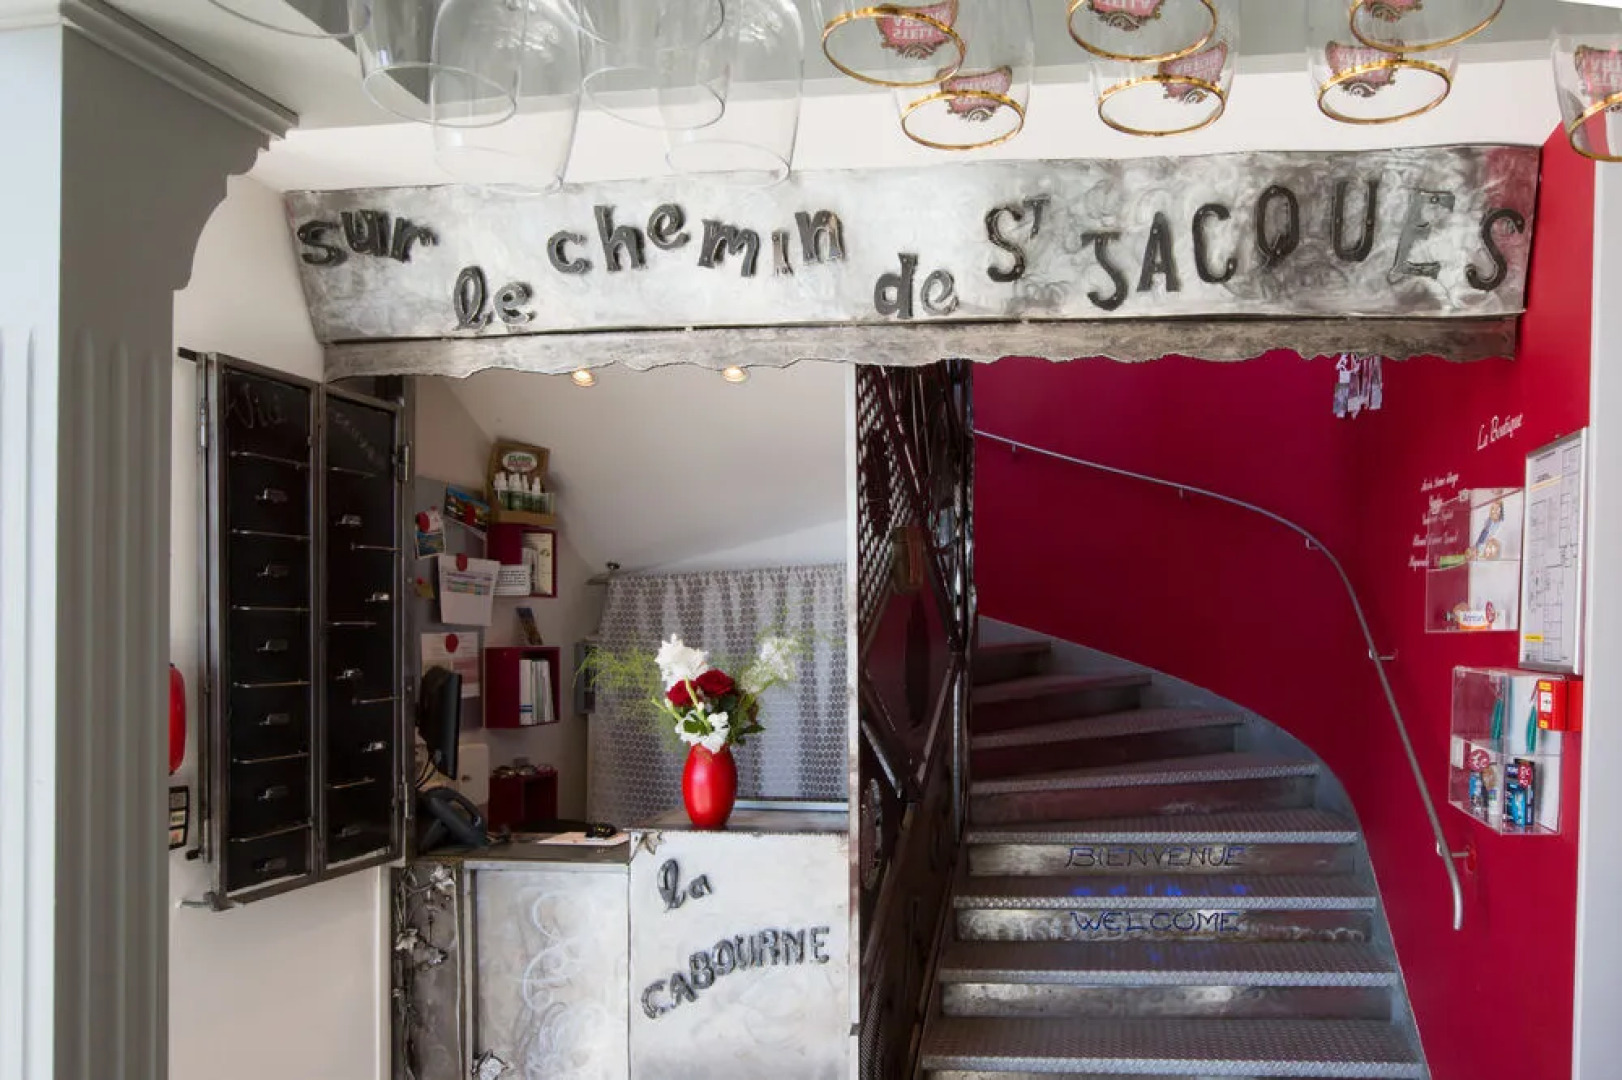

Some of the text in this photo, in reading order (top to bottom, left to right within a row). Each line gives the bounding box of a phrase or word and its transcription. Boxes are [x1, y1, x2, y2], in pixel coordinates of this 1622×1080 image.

[297, 208, 440, 264] sur
[452, 265, 538, 332] le
[547, 202, 848, 278] chemin
[873, 252, 961, 319] de
[1079, 180, 1525, 312] JACQUES
[1064, 846, 1247, 868] BIENVENUE
[656, 858, 713, 914] la
[1069, 911, 1240, 932] WELCOME
[640, 925, 831, 1020] CABOURNE
